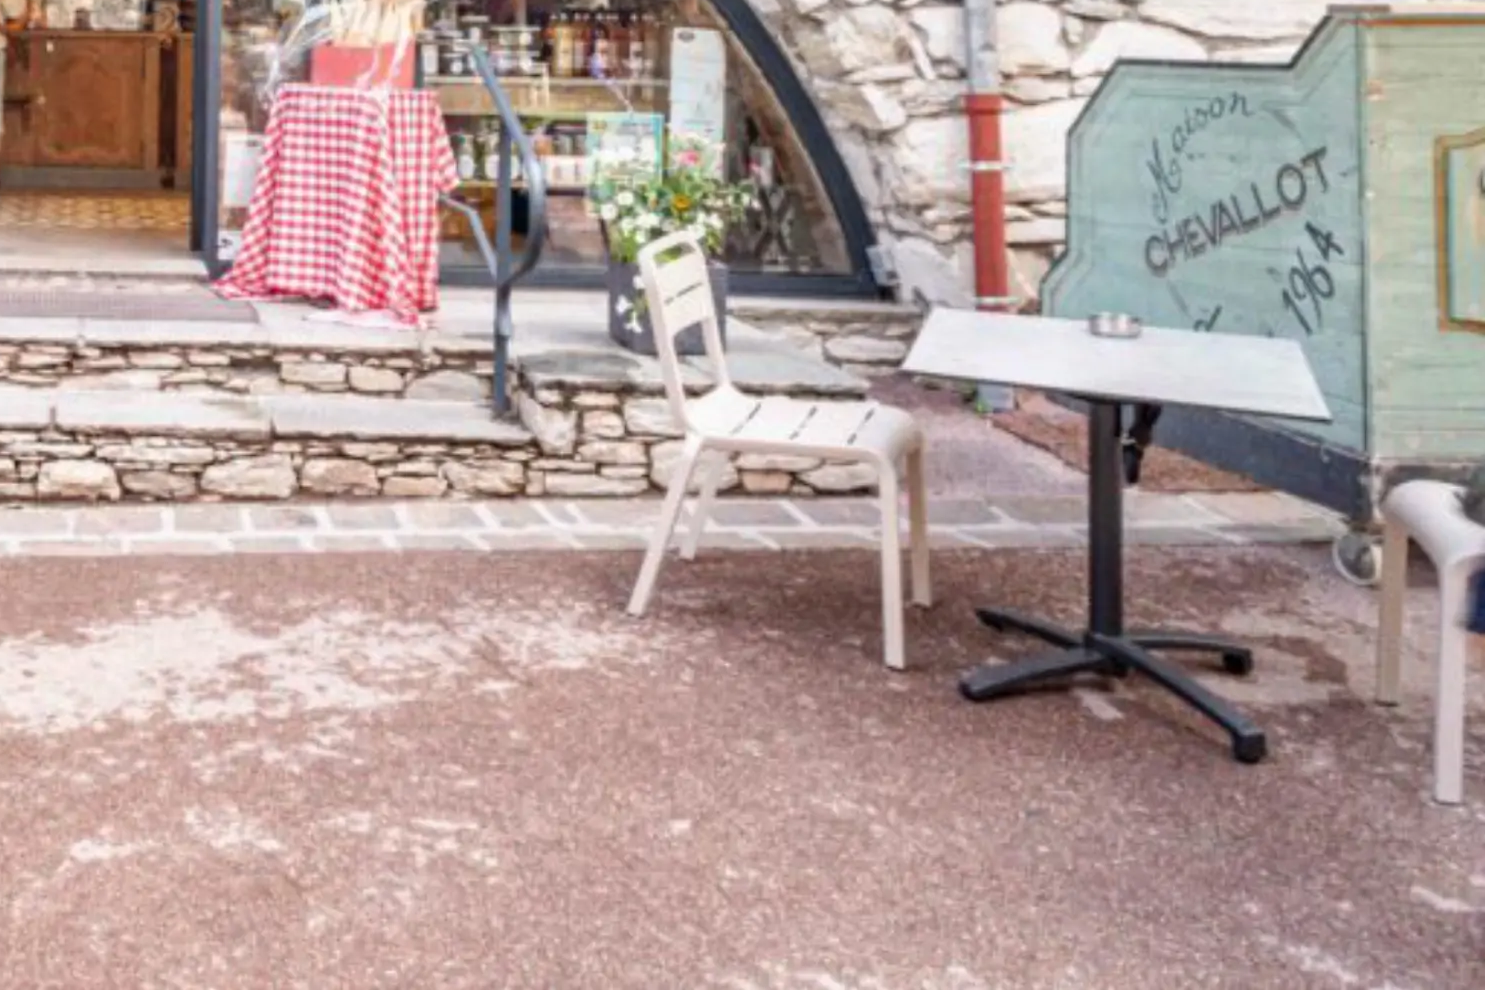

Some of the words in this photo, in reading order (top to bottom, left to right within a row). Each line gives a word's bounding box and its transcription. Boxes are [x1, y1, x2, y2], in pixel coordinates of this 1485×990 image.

[1145, 146, 1329, 276] CHEVALLOT
[1147, 91, 1255, 224] Maison
[1282, 221, 1344, 335] 1964
